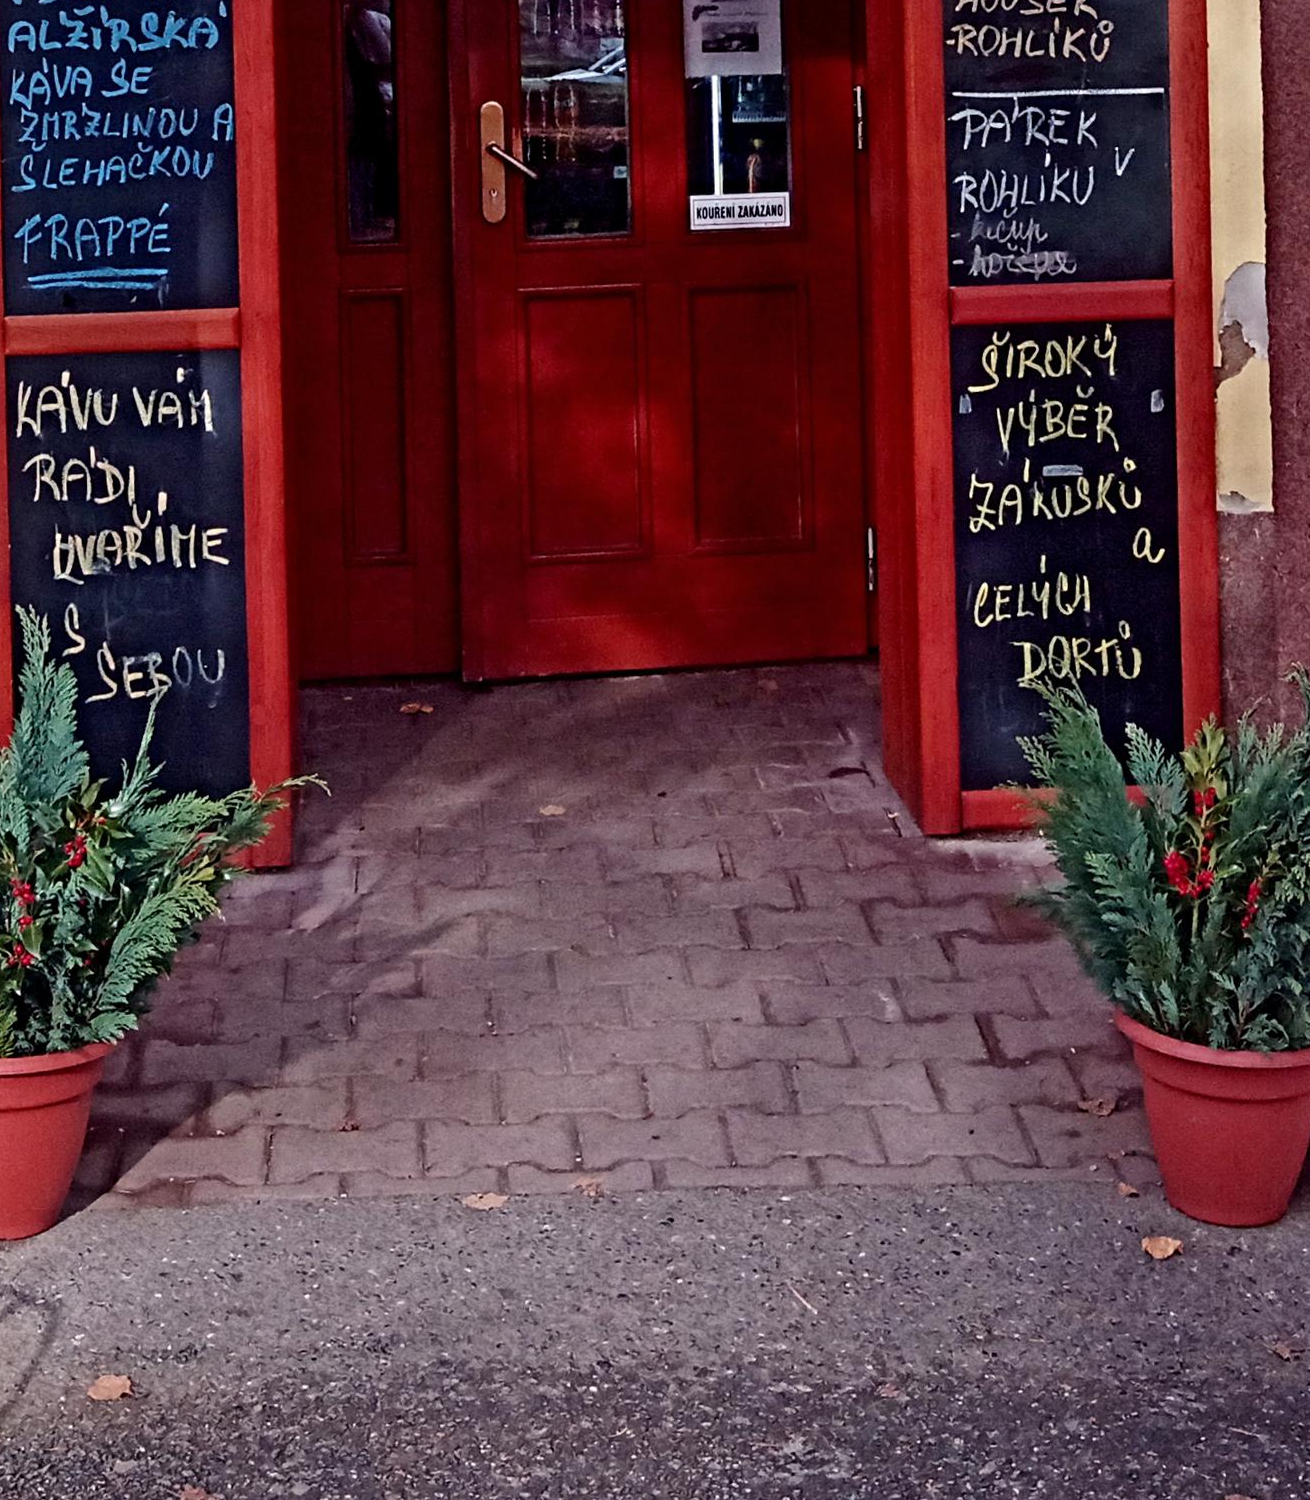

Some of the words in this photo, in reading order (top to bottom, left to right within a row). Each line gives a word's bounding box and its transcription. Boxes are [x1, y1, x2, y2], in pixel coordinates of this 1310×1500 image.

[9, 57, 92, 109] KÁVA
[101, 58, 153, 97] SE
[19, 102, 198, 142] ZMRZLINOU
[212, 103, 233, 141] A
[948, 97, 1098, 150] PÁREK
[11, 141, 215, 192] ŠLEHAČKOU
[953, 149, 1094, 213] ROHLÍKU
[14, 203, 171, 264] FRAPPÉ
[696, 203, 735, 219] KOUŘENÍ
[738, 202, 783, 218] ZAKÁZÁNO
[967, 324, 1117, 392] ŠIROKÝ
[17, 369, 118, 438] KÁVU
[133, 366, 215, 432] VÁM
[996, 385, 1119, 453] VÝBĚR
[22, 446, 136, 505] RÁDI
[969, 457, 1142, 533] ZÁKUSKŮ
[1132, 527, 1165, 563] a
[973, 555, 1092, 627] CELÝCH
[63, 603, 85, 657] S
[1009, 620, 1143, 687] DORTŮ
